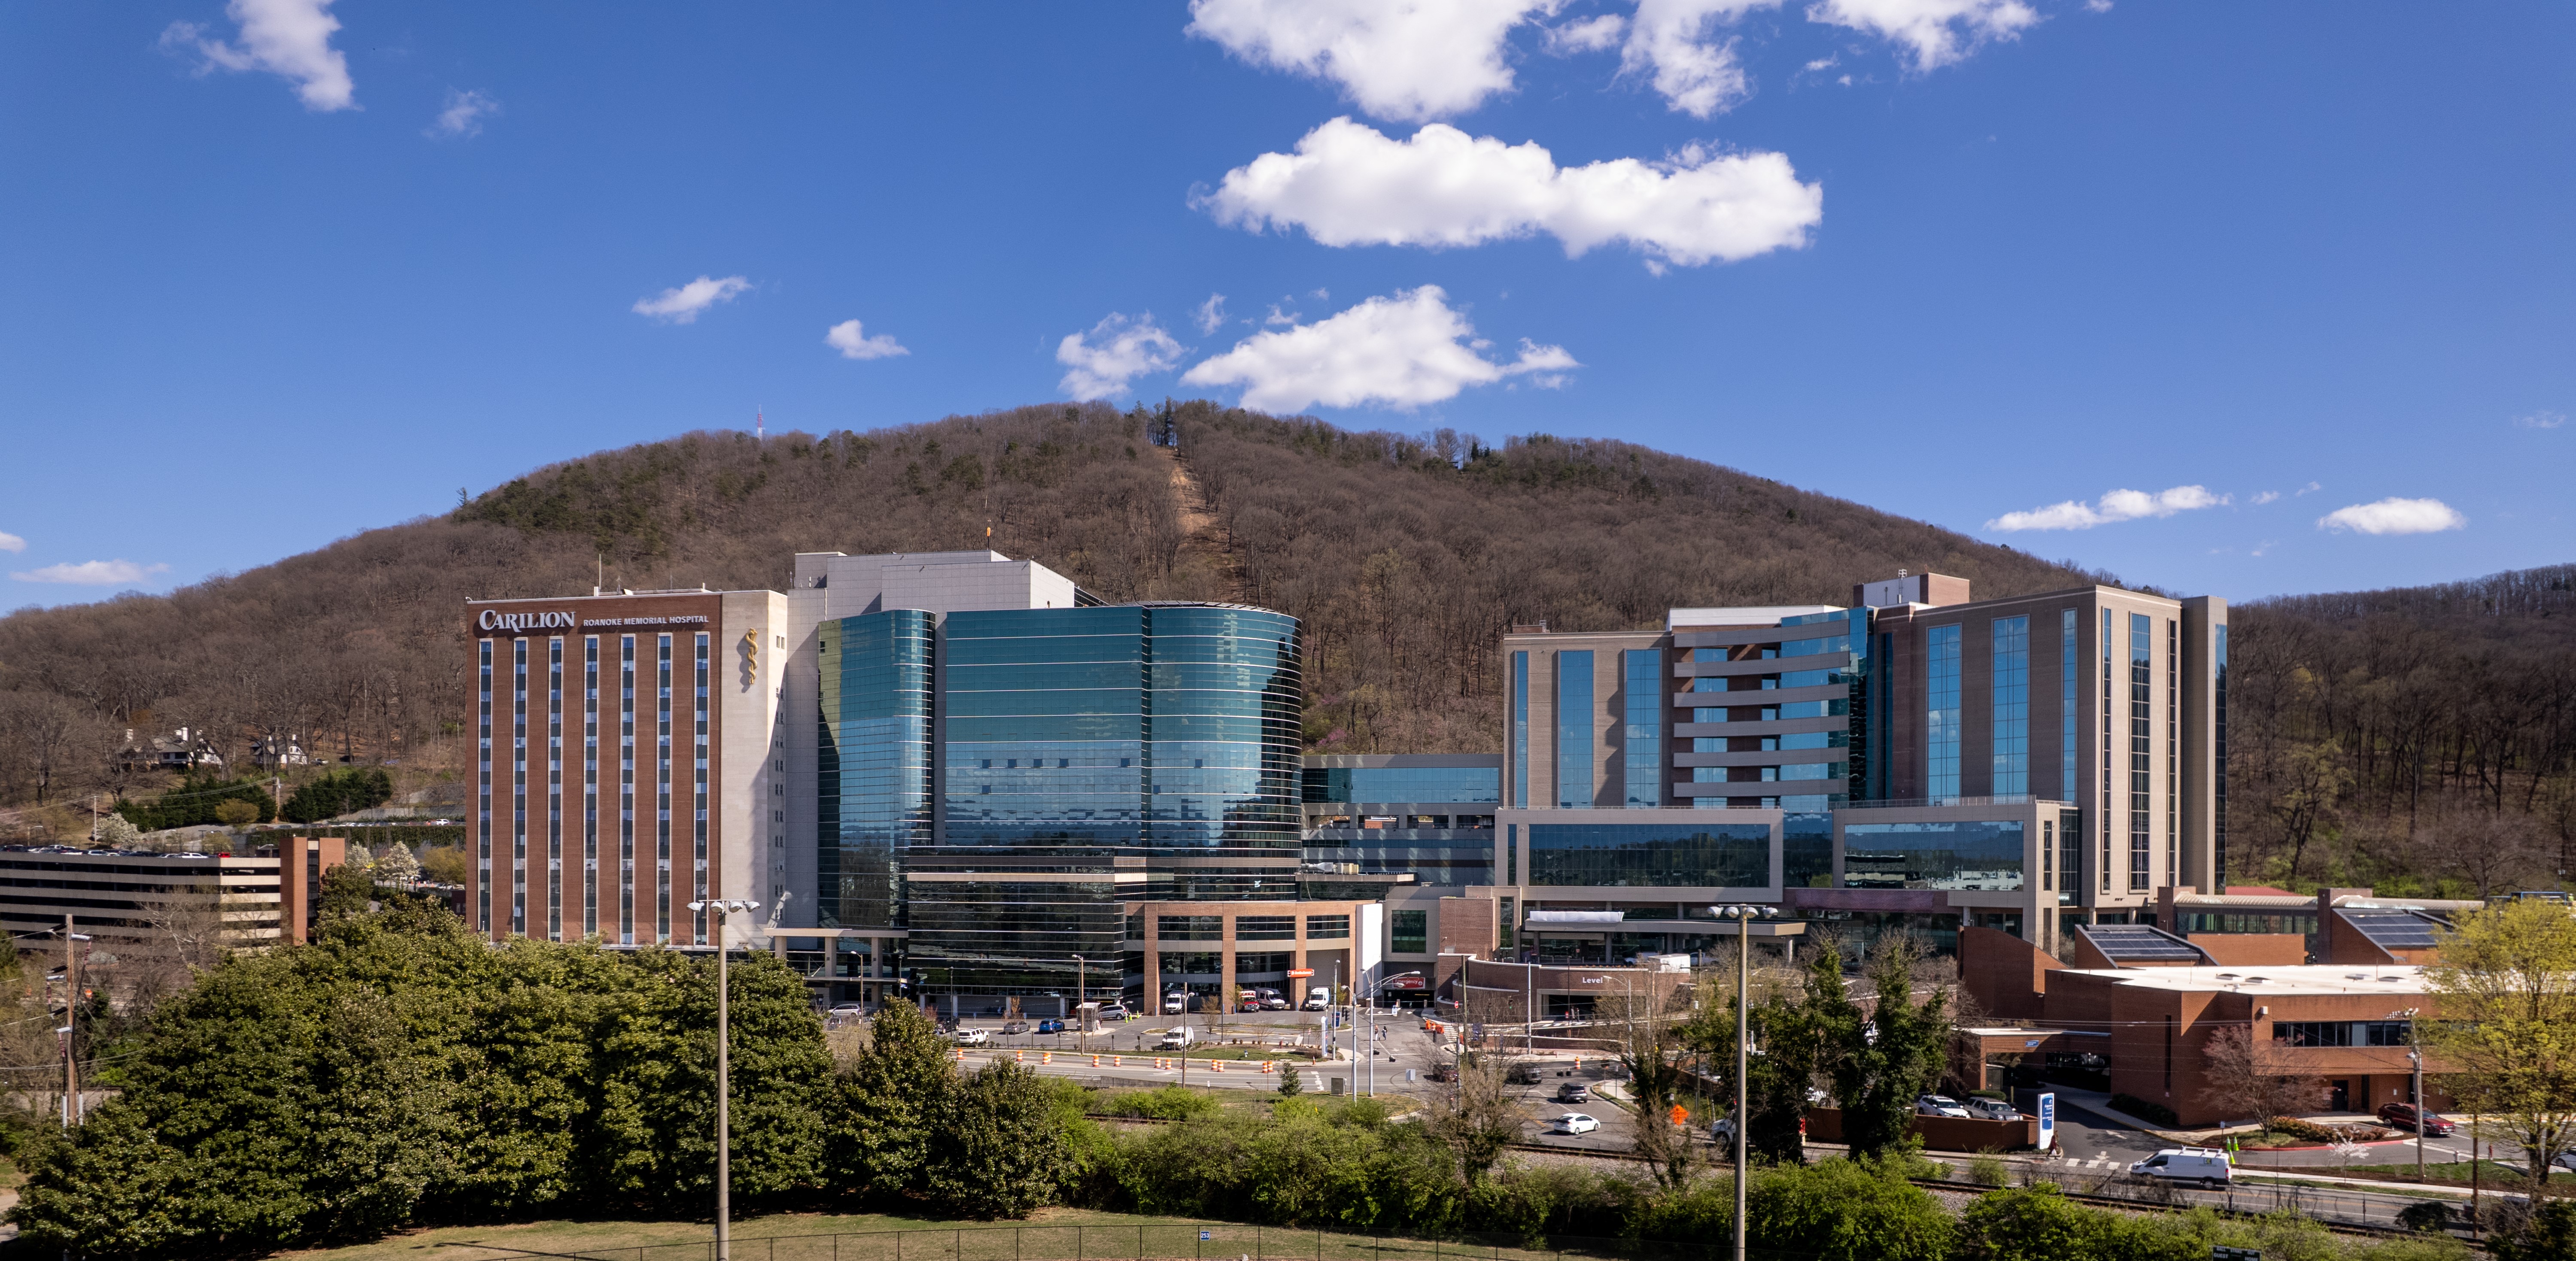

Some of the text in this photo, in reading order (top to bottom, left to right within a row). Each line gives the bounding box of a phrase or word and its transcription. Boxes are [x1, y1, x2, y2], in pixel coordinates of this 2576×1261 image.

[479, 609, 576, 633] CARILION
[624, 617, 667, 625] MEMORIAL
[669, 615, 709, 624] HOSPITAL
